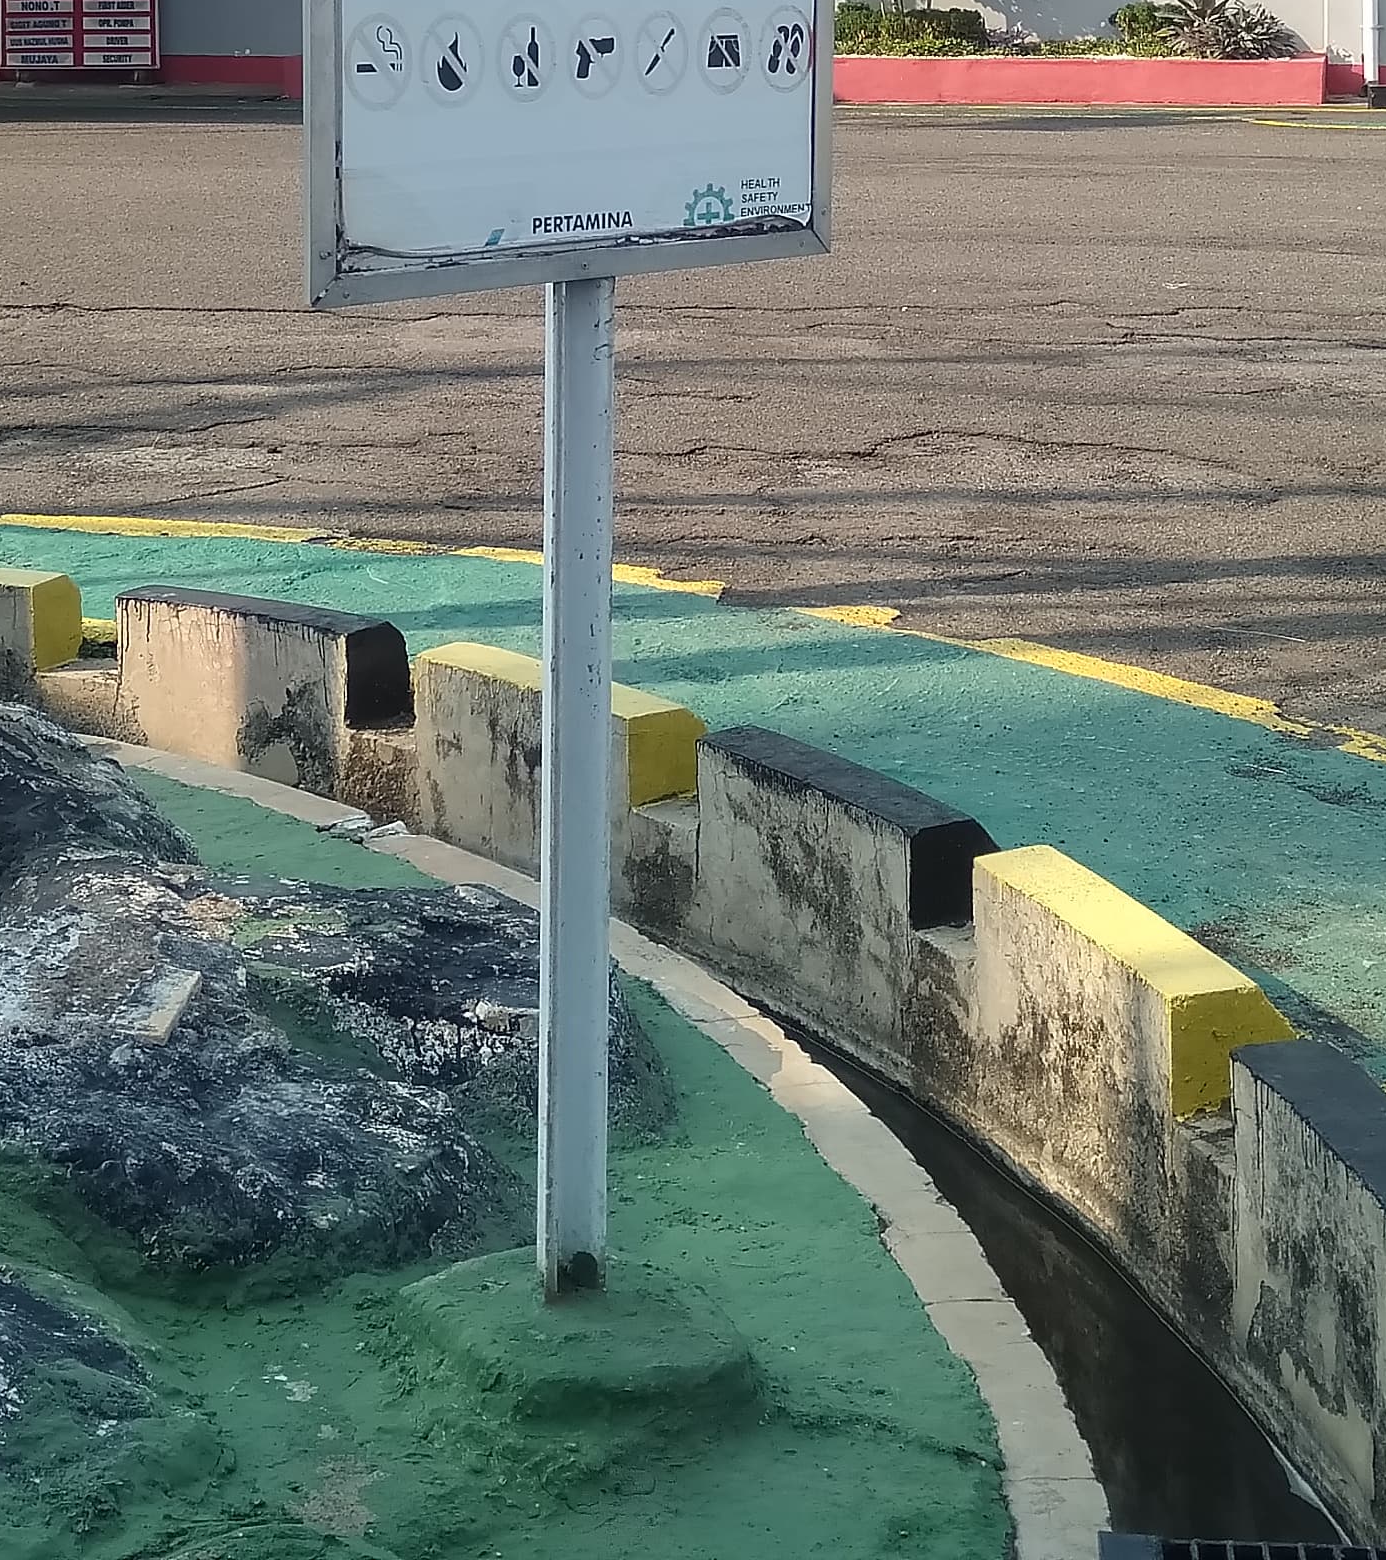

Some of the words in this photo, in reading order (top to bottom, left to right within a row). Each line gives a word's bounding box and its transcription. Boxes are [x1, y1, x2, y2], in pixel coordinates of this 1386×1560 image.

[740, 177, 780, 190] HEALTH
[740, 191, 778, 204] SAFETY
[740, 203, 812, 217] ENVIRONMENT
[531, 209, 634, 236] PERTAMINA
